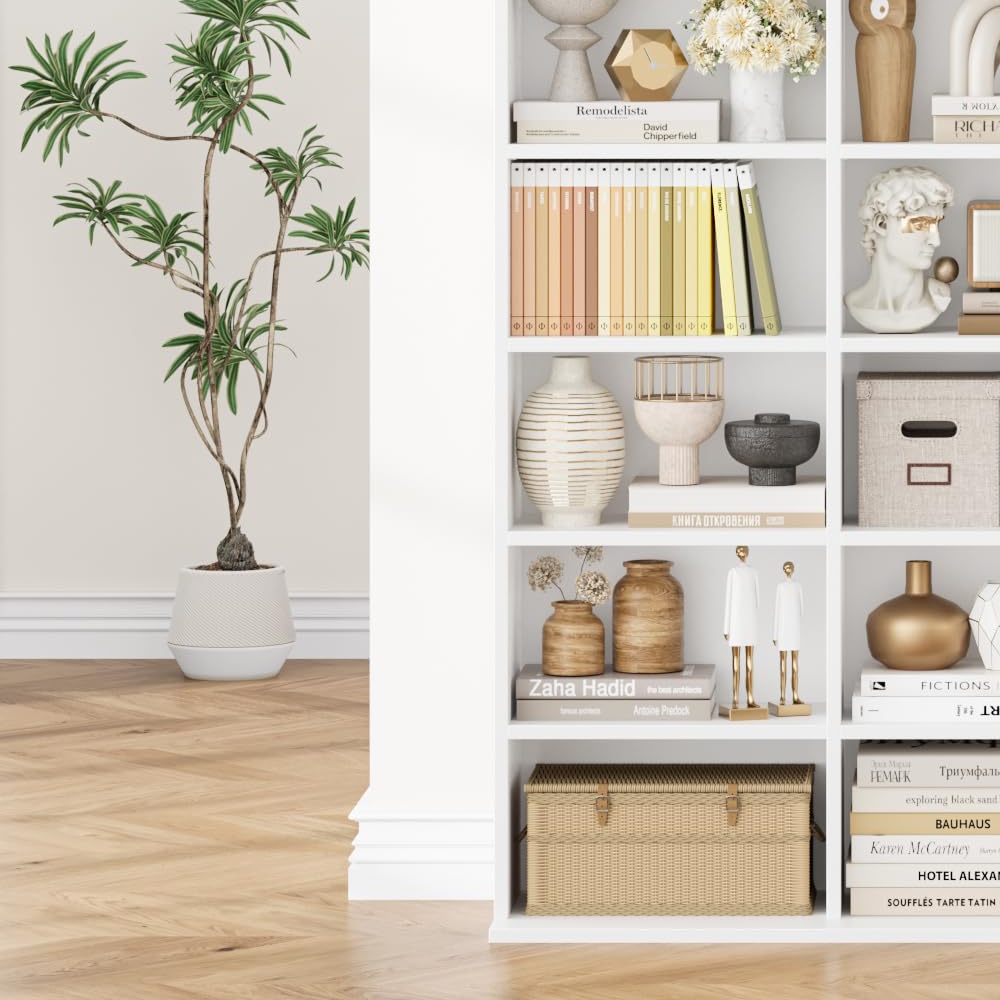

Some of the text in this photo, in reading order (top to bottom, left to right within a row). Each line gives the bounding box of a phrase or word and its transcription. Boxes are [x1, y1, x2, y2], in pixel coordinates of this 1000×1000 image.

[576, 105, 648, 115] Remodelista
[643, 123, 668, 131] David
[643, 132, 697, 140] Chipperfield
[672, 515, 702, 527] КНИГА
[703, 515, 761, 527] ОТКРОВЕНИЯ
[529, 679, 636, 697] Zaha Hadid
[921, 681, 991, 690] FICTIONS
[905, 795, 948, 806] exploring
[951, 795, 975, 806] black
[977, 795, 998, 806] sand
[935, 819, 991, 829] BAUHAUS
[870, 841, 970, 857] Karen McCartney
[918, 871, 956, 881] HOTEL
[887, 896, 933, 907] SOUFFLÉS
[936, 896, 966, 907] TARTE
[968, 896, 996, 907] TATIN
